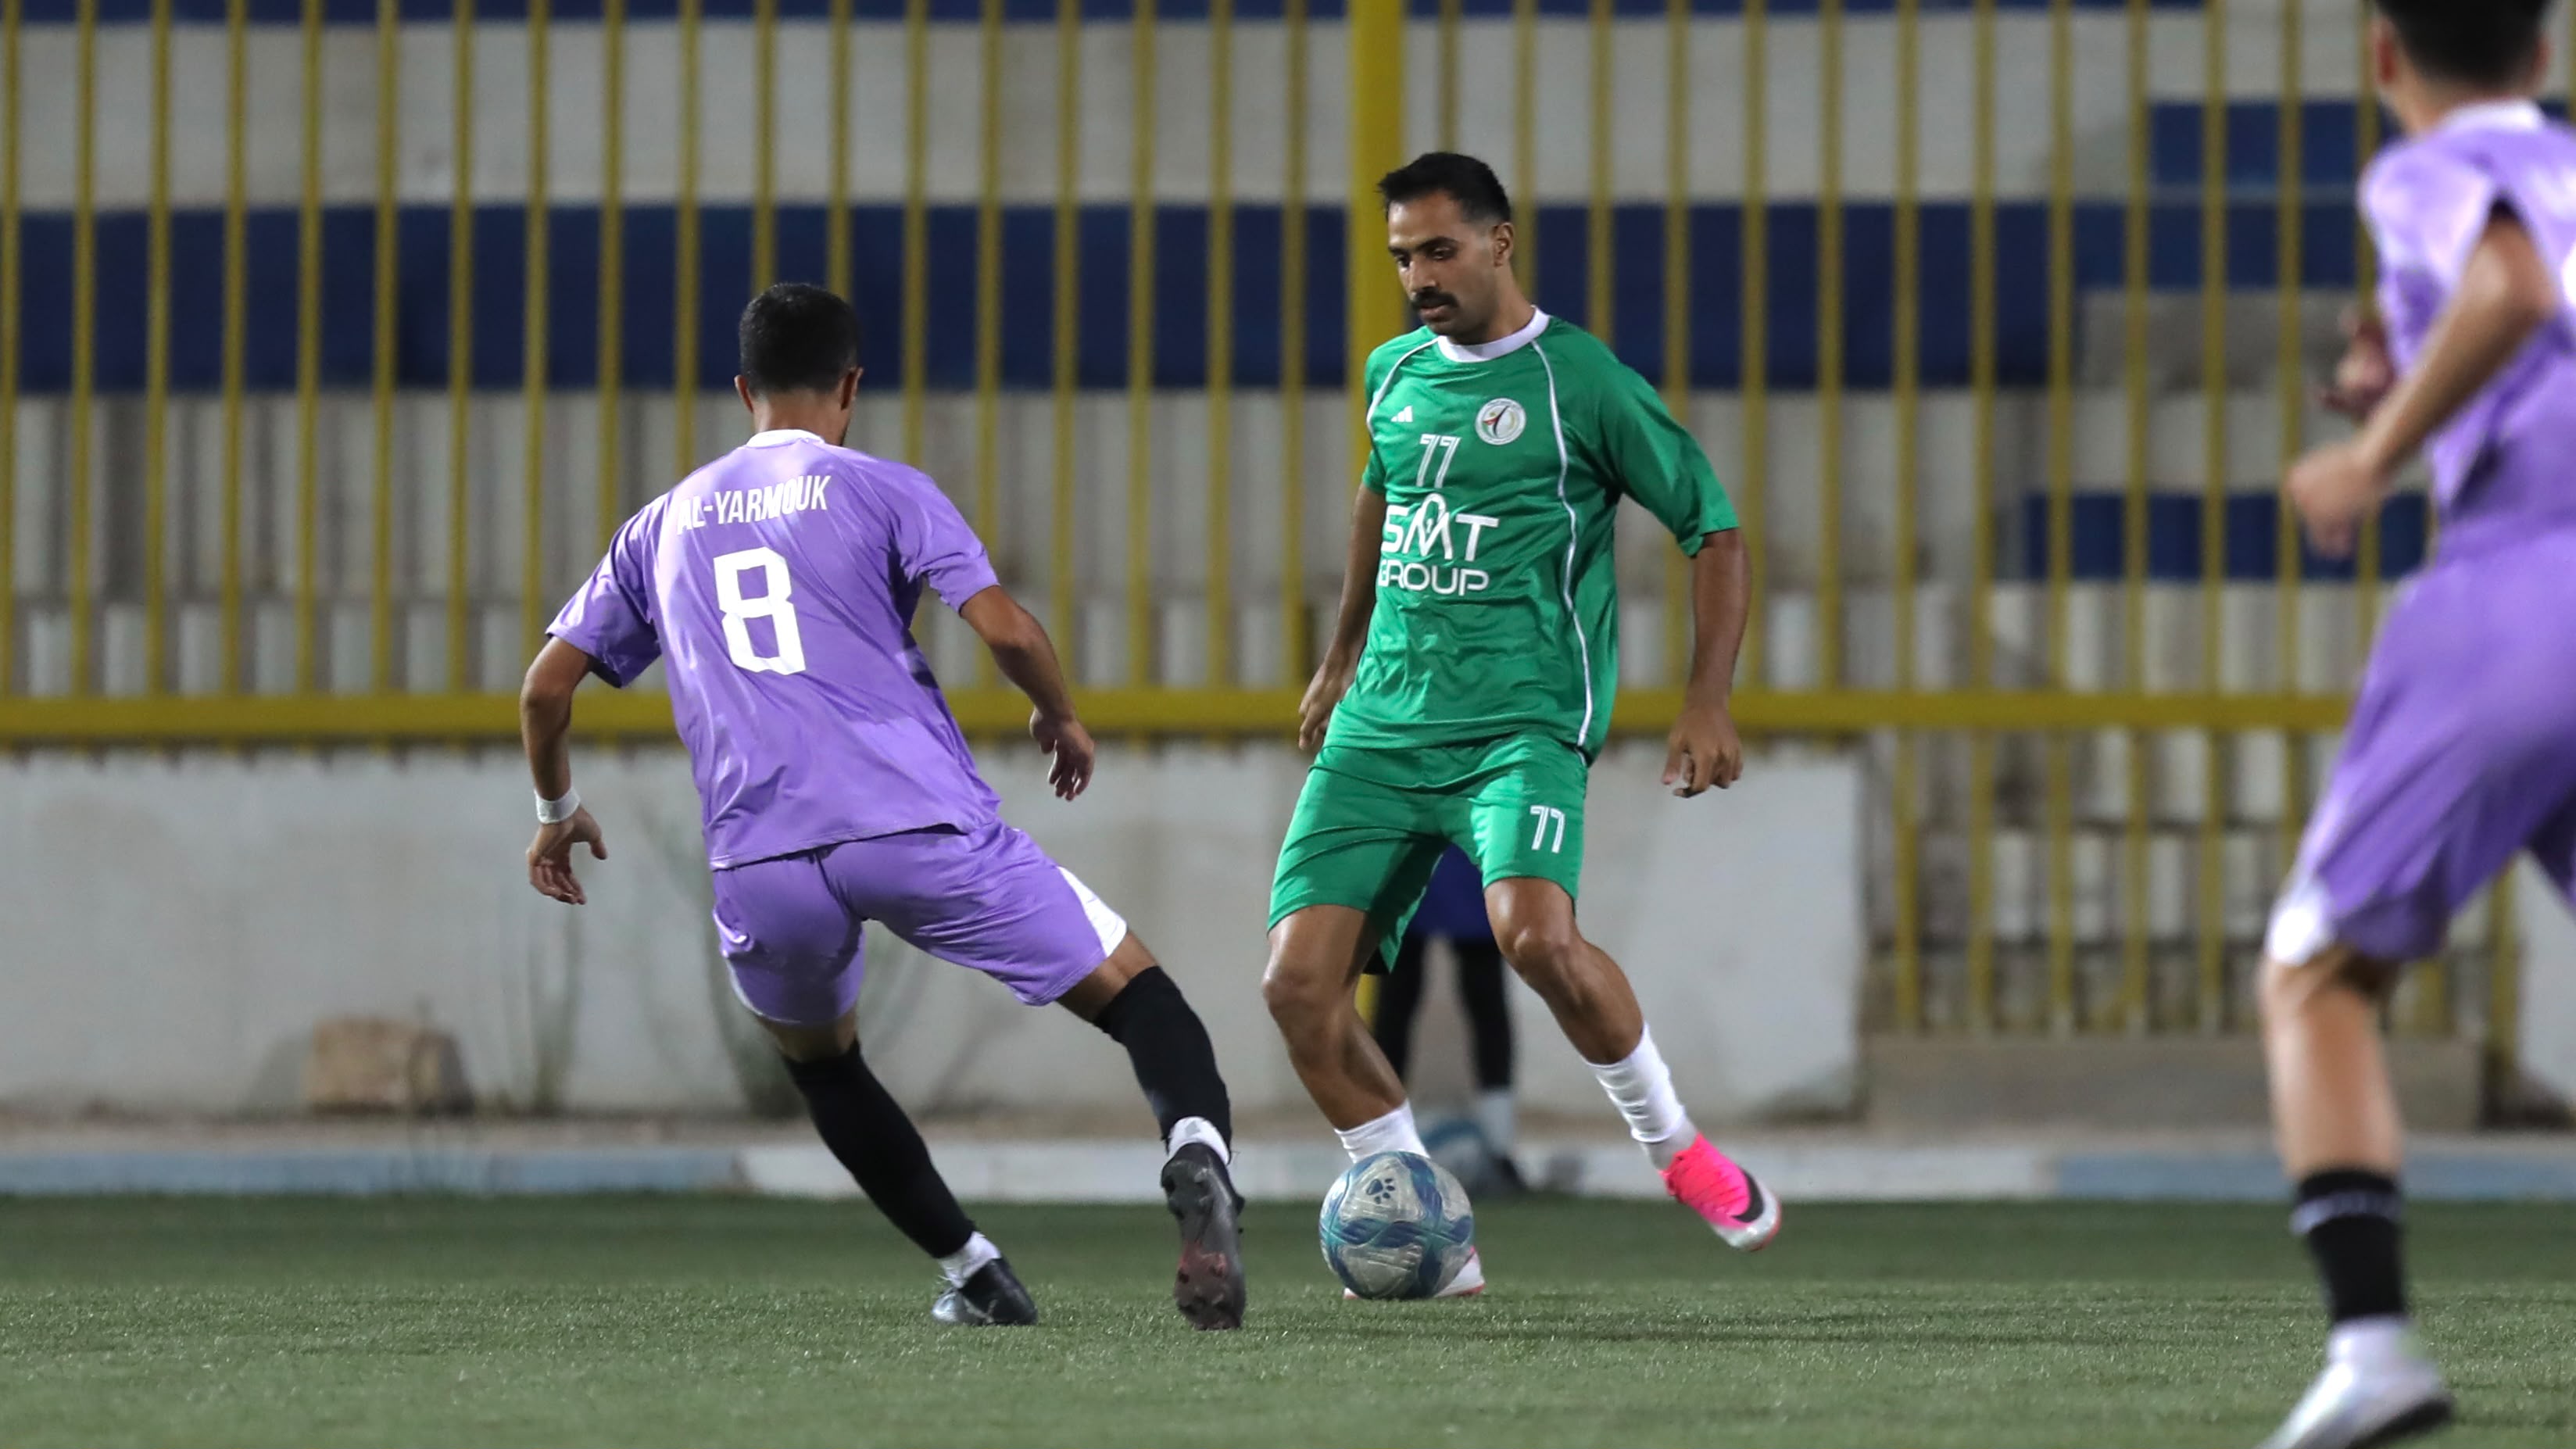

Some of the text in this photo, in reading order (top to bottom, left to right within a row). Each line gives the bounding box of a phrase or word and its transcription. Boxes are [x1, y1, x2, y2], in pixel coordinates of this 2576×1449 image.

[1415, 433, 1461, 488] 77
[676, 475, 831, 535] AL-YARMOUK
[1380, 492, 1499, 562] SMT
[713, 546, 806, 675] 8
[1530, 805, 1565, 853] 77
